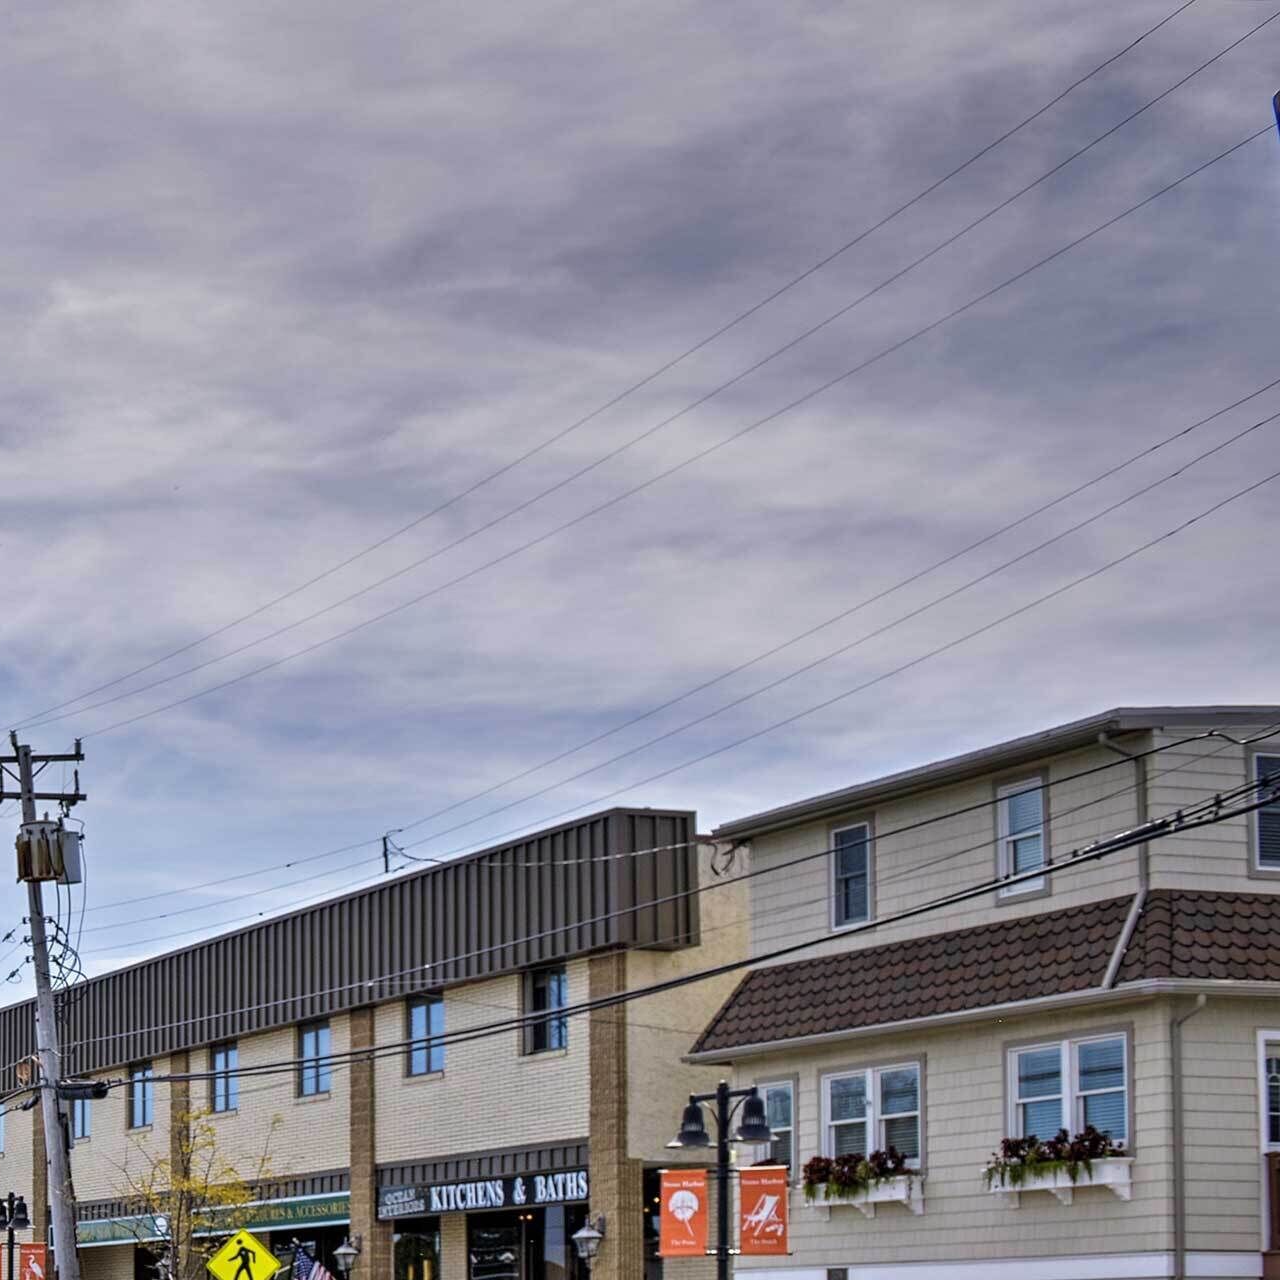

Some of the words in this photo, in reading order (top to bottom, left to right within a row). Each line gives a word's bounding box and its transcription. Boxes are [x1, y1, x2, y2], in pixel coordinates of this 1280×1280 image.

[430, 1179, 504, 1212] KITCHENS
[513, 1177, 526, 1205] &
[534, 1171, 589, 1204] BATHS
